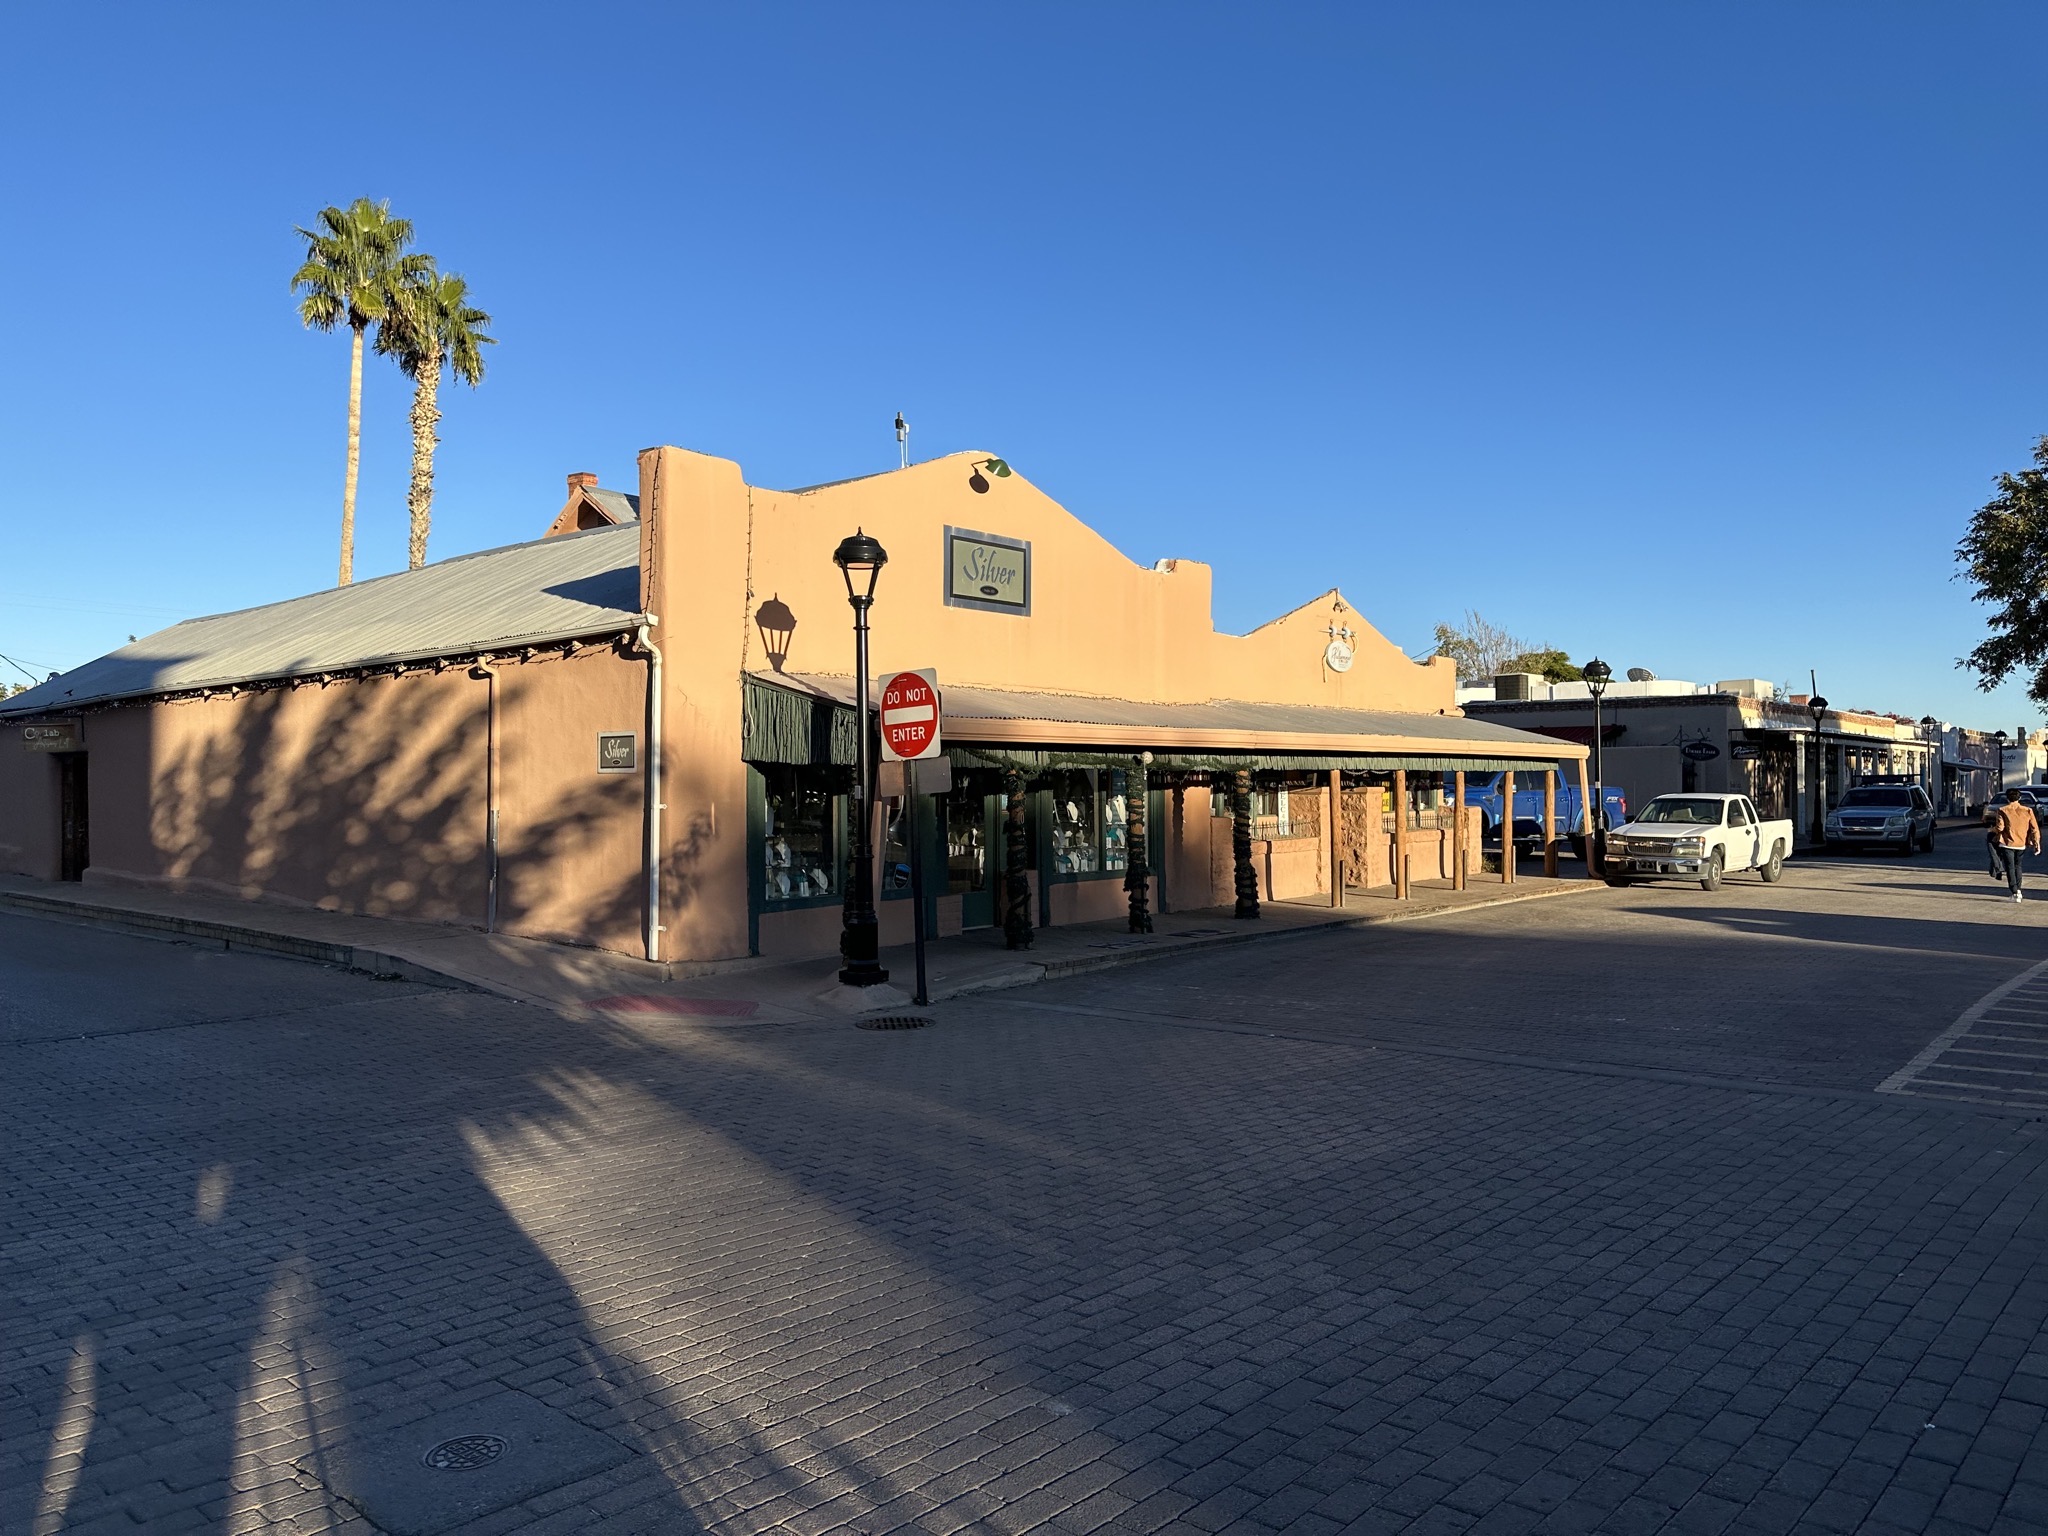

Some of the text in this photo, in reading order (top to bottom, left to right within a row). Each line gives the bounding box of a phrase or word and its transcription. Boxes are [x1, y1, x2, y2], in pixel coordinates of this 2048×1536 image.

[963, 547, 1016, 585] Silver
[887, 688, 927, 705] DO NOT
[892, 726, 926, 743] ENTER
[604, 739, 630, 759] Silver
